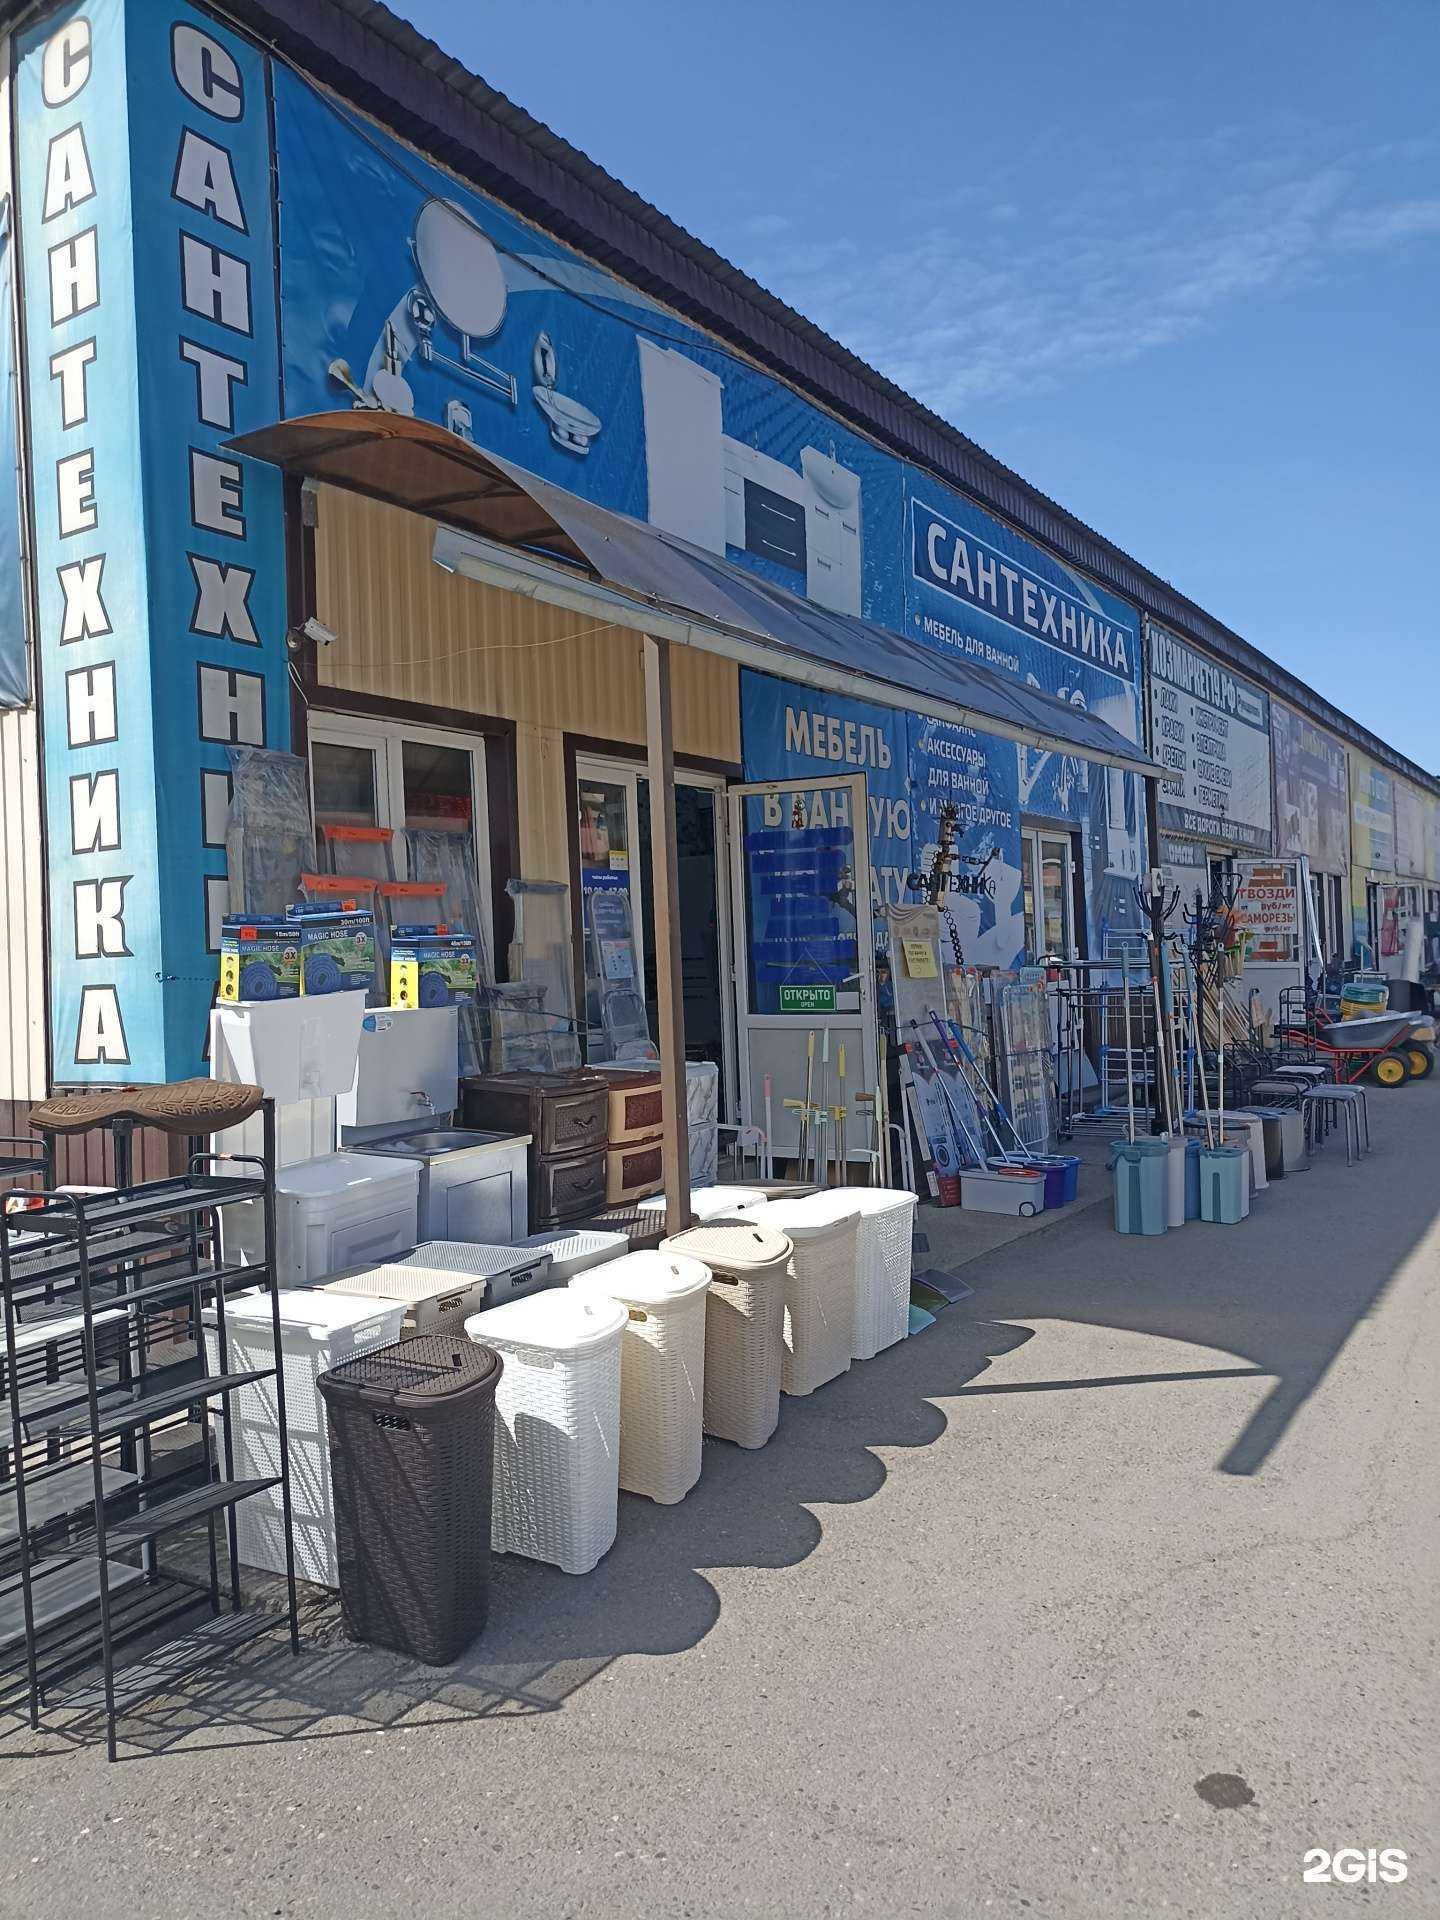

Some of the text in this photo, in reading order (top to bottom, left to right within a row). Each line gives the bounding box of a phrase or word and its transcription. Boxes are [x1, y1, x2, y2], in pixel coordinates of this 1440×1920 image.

[42, 15, 134, 1065] САНТЕХНИКА
[169, 19, 267, 1063] САНТЕХН
[927, 522, 1129, 674] САНТЕХНИКА
[924, 616, 1020, 673] МЕБЕЛЬ ДЛЯ ВАННОЙ
[784, 705, 892, 770] МЕБЕЛЬ
[927, 737, 986, 768] АКСЕССУАРЫ
[928, 767, 989, 796] ДЛЯ ВАННОЙ
[764, 792, 783, 828] В
[979, 808, 1012, 829] ДРУГОЕ
[307, 930, 349, 941] MAGIC HOSE
[784, 989, 831, 1001] ОТКРЫТО
